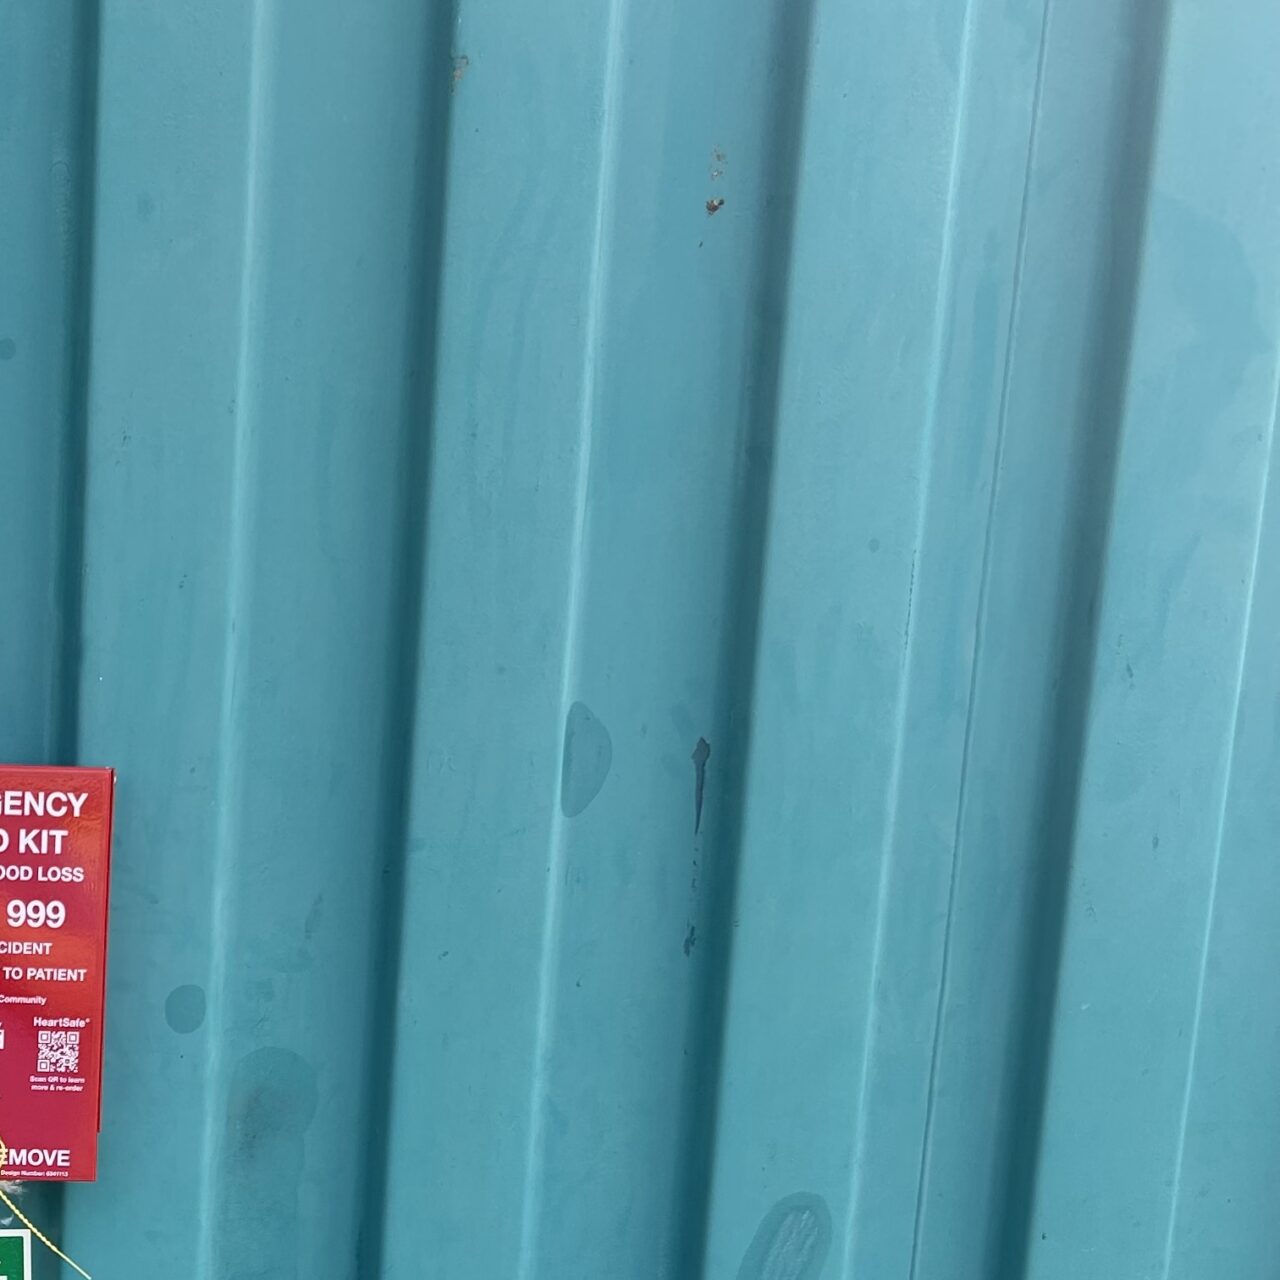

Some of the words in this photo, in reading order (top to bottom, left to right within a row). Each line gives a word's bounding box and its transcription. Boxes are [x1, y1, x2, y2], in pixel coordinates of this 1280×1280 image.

[19, 829, 68, 854] KIT
[38, 867, 84, 882] LOSS
[7, 899, 65, 928] 999
[3, 967, 23, 980] TO
[27, 968, 87, 981] PATIENT
